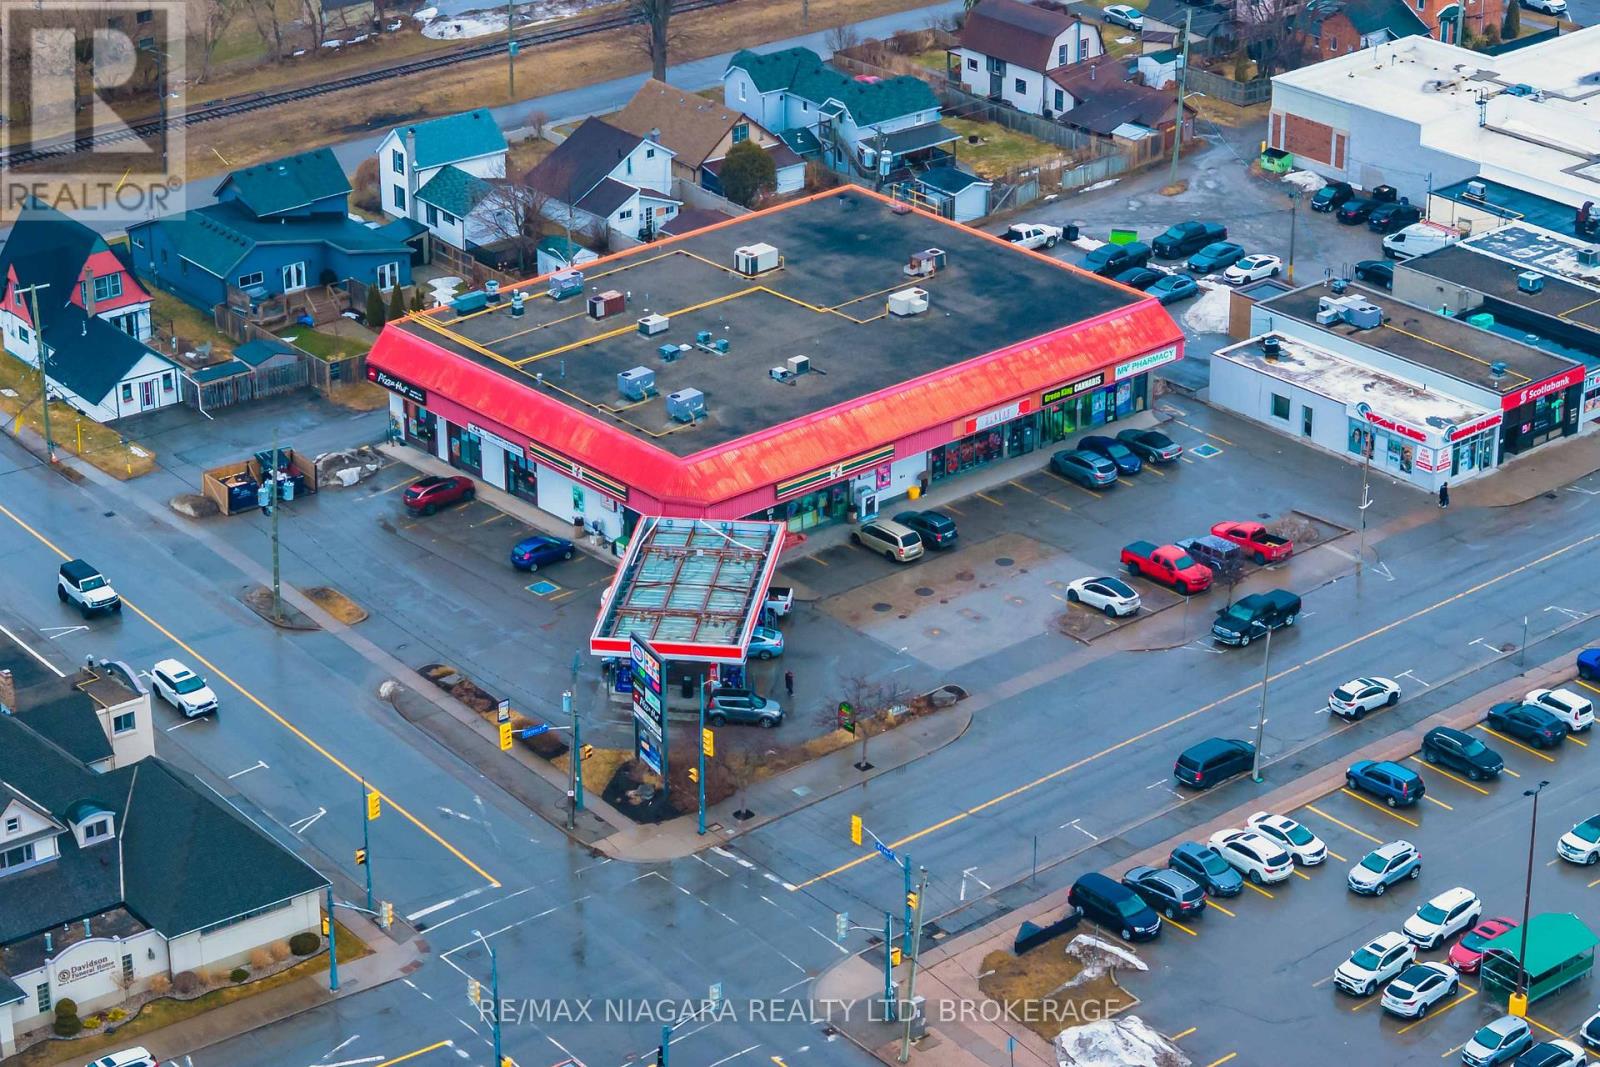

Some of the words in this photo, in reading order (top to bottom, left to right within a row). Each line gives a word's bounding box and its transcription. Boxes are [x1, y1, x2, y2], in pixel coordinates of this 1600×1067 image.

[1132, 349, 1174, 369] PHARMACY
[377, 372, 395, 387] Pizza
[395, 381, 409, 393] Hut
[1074, 375, 1101, 393] CANNABIS
[1529, 376, 1570, 399] Scotiabank
[71, 956, 108, 974] Davidson
[71, 967, 95, 979] Funeral
[97, 961, 115, 970] Home
